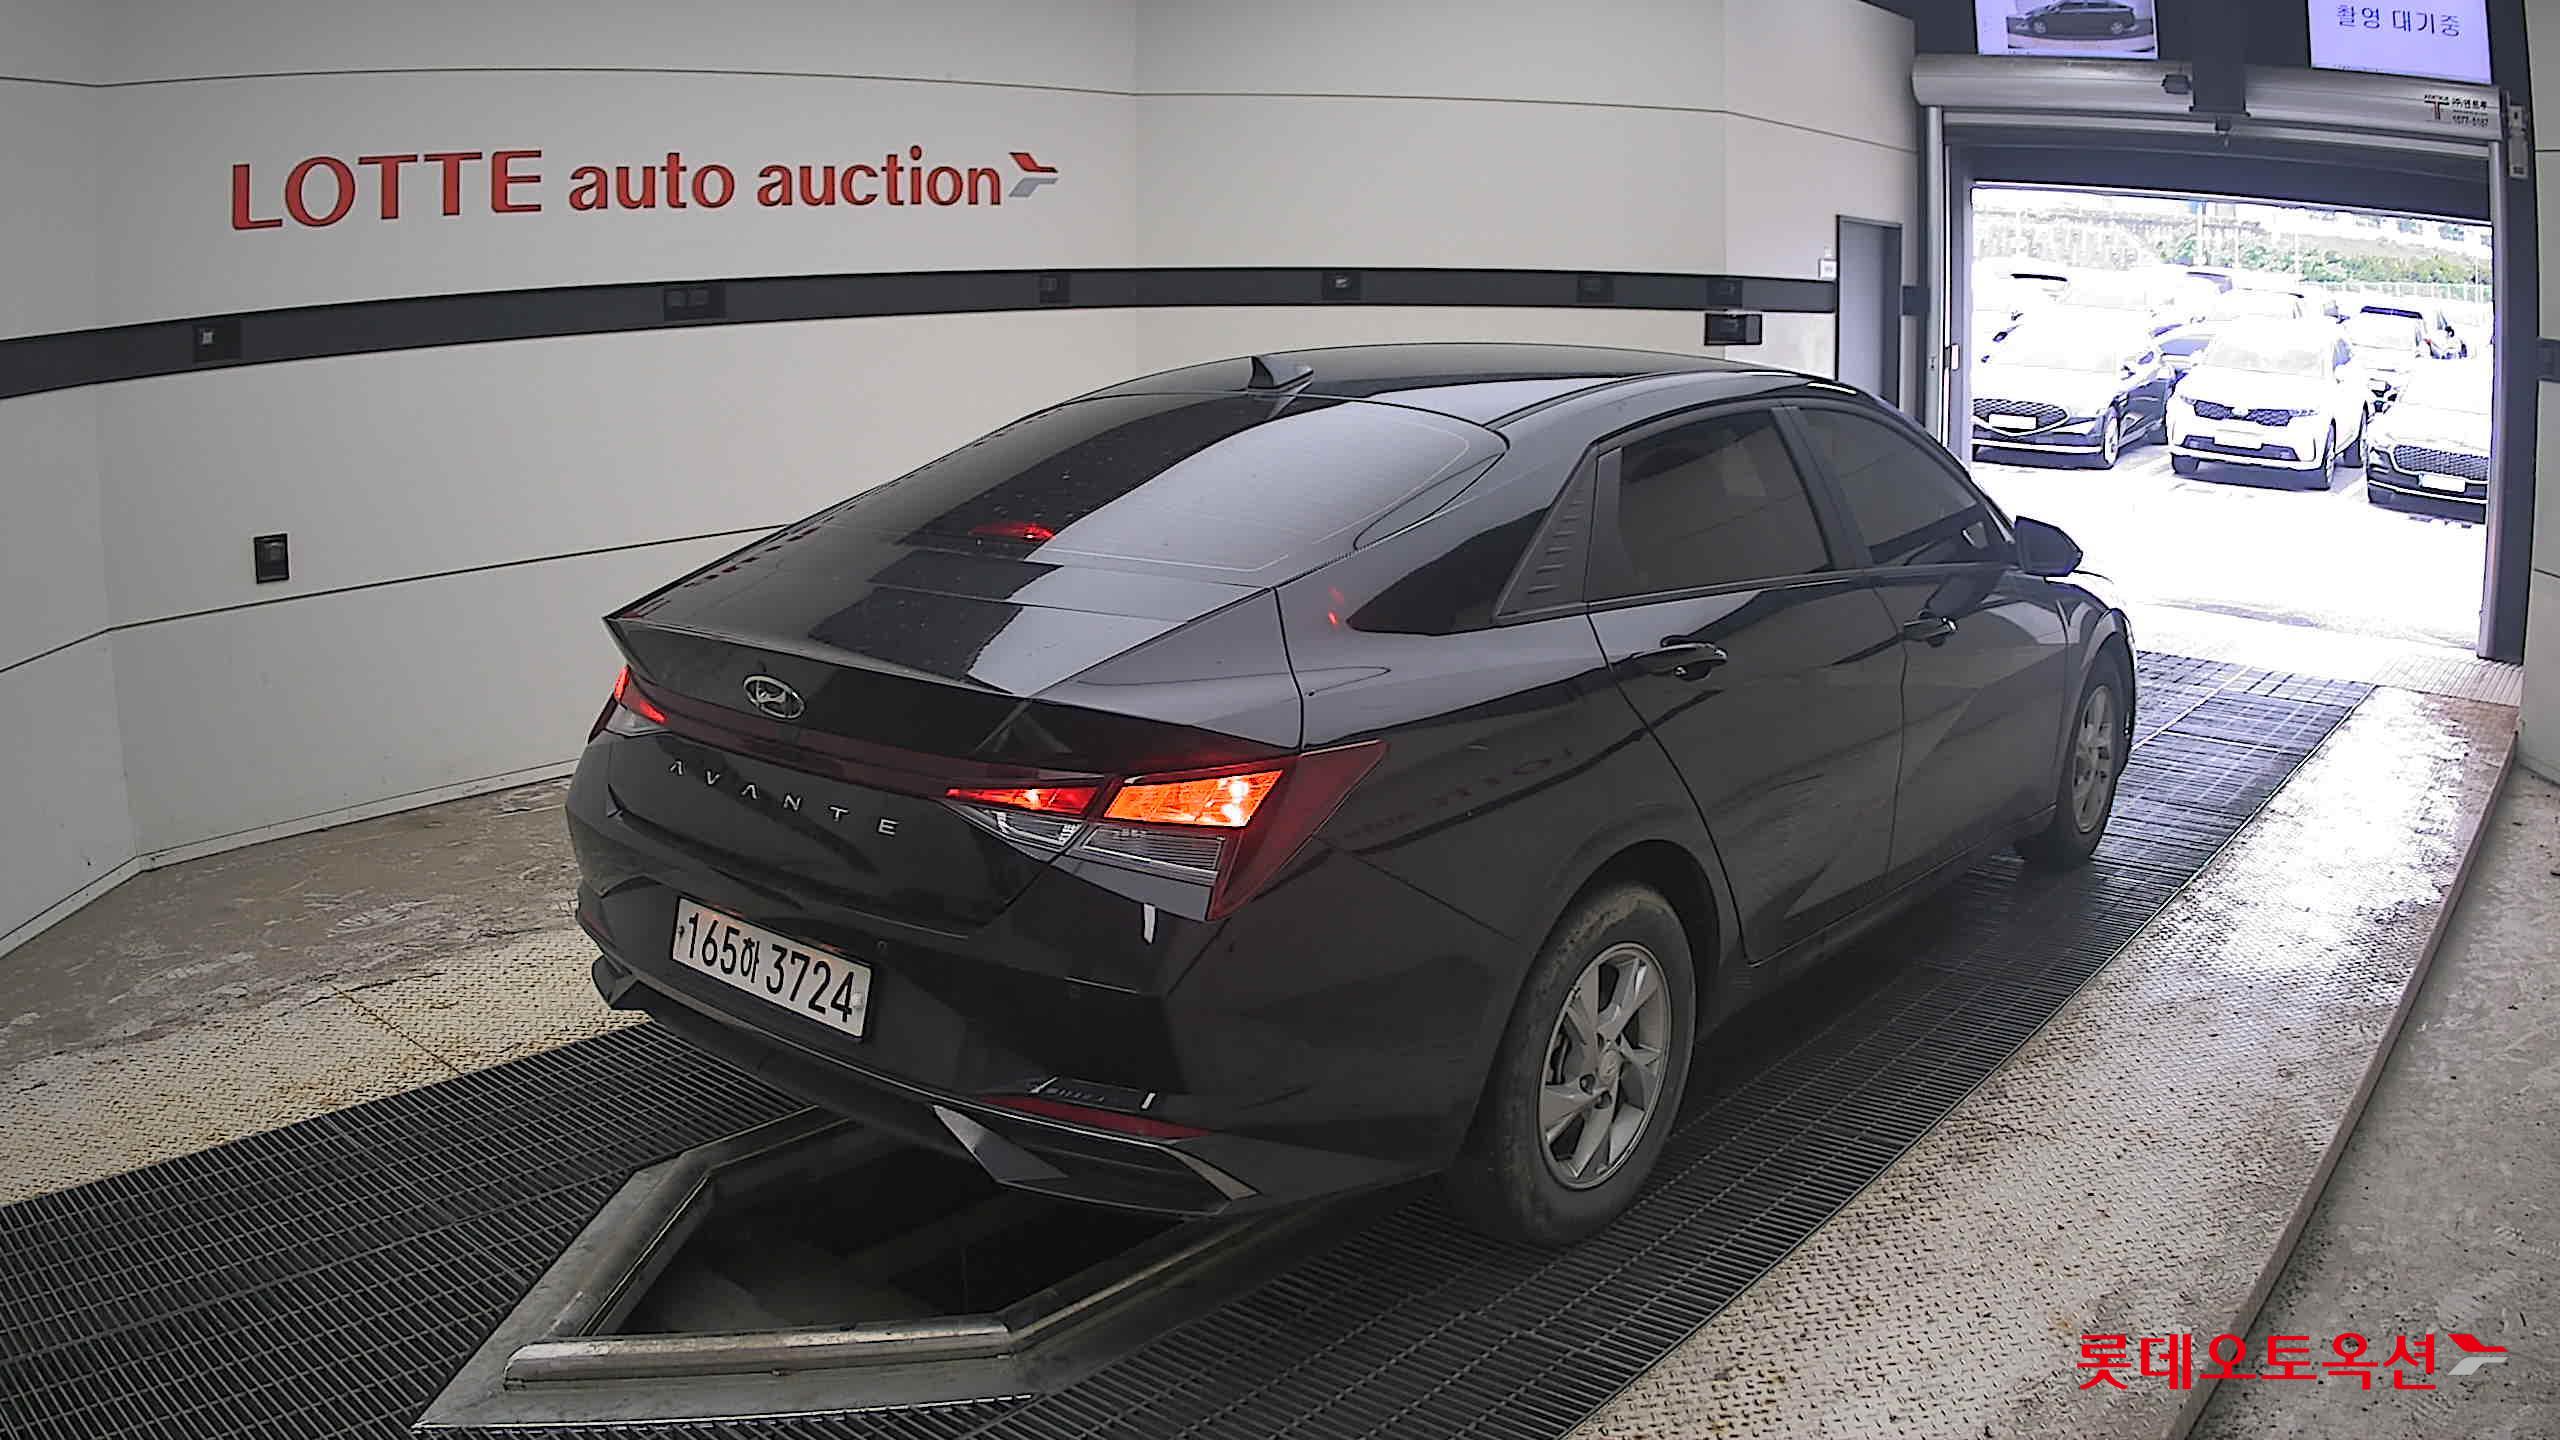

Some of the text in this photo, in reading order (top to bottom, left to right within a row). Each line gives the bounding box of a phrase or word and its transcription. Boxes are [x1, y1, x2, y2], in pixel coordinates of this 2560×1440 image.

[2336, 4, 2461, 38] 촬영 대기중
[232, 145, 1003, 232] LOTTE auto auction
[669, 759, 899, 836] AVANTE
